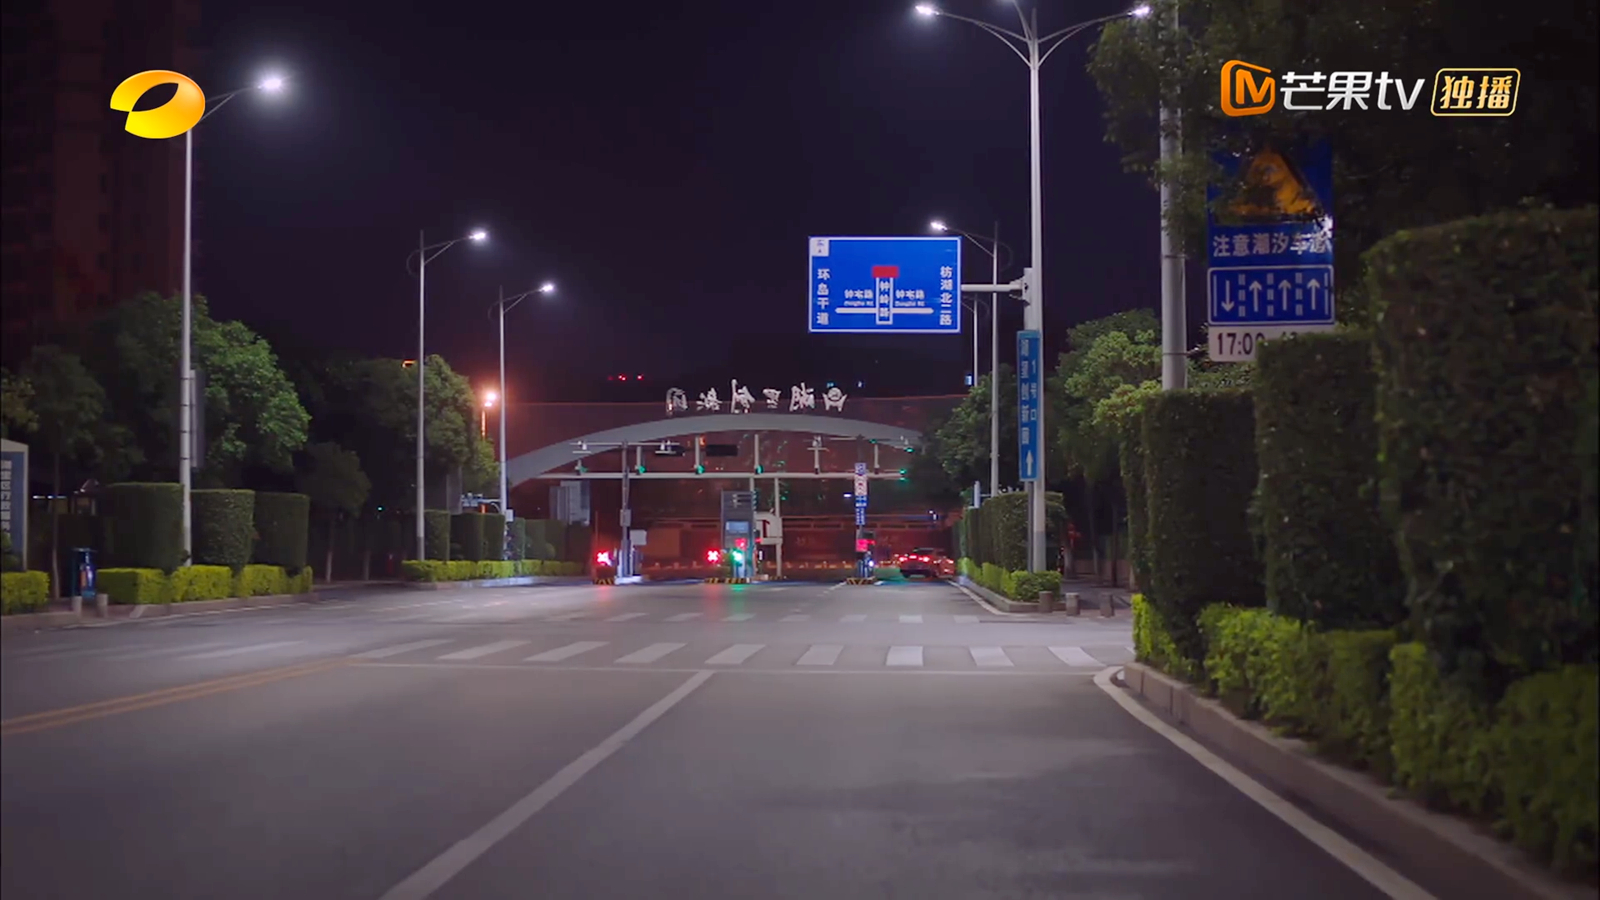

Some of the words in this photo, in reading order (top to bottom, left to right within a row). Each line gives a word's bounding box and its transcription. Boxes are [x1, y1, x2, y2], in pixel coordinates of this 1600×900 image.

[1213, 231, 1332, 257] 注意潮汐车道
[817, 268, 830, 325] 环岛干道
[940, 266, 953, 325] 枋湖北二路
